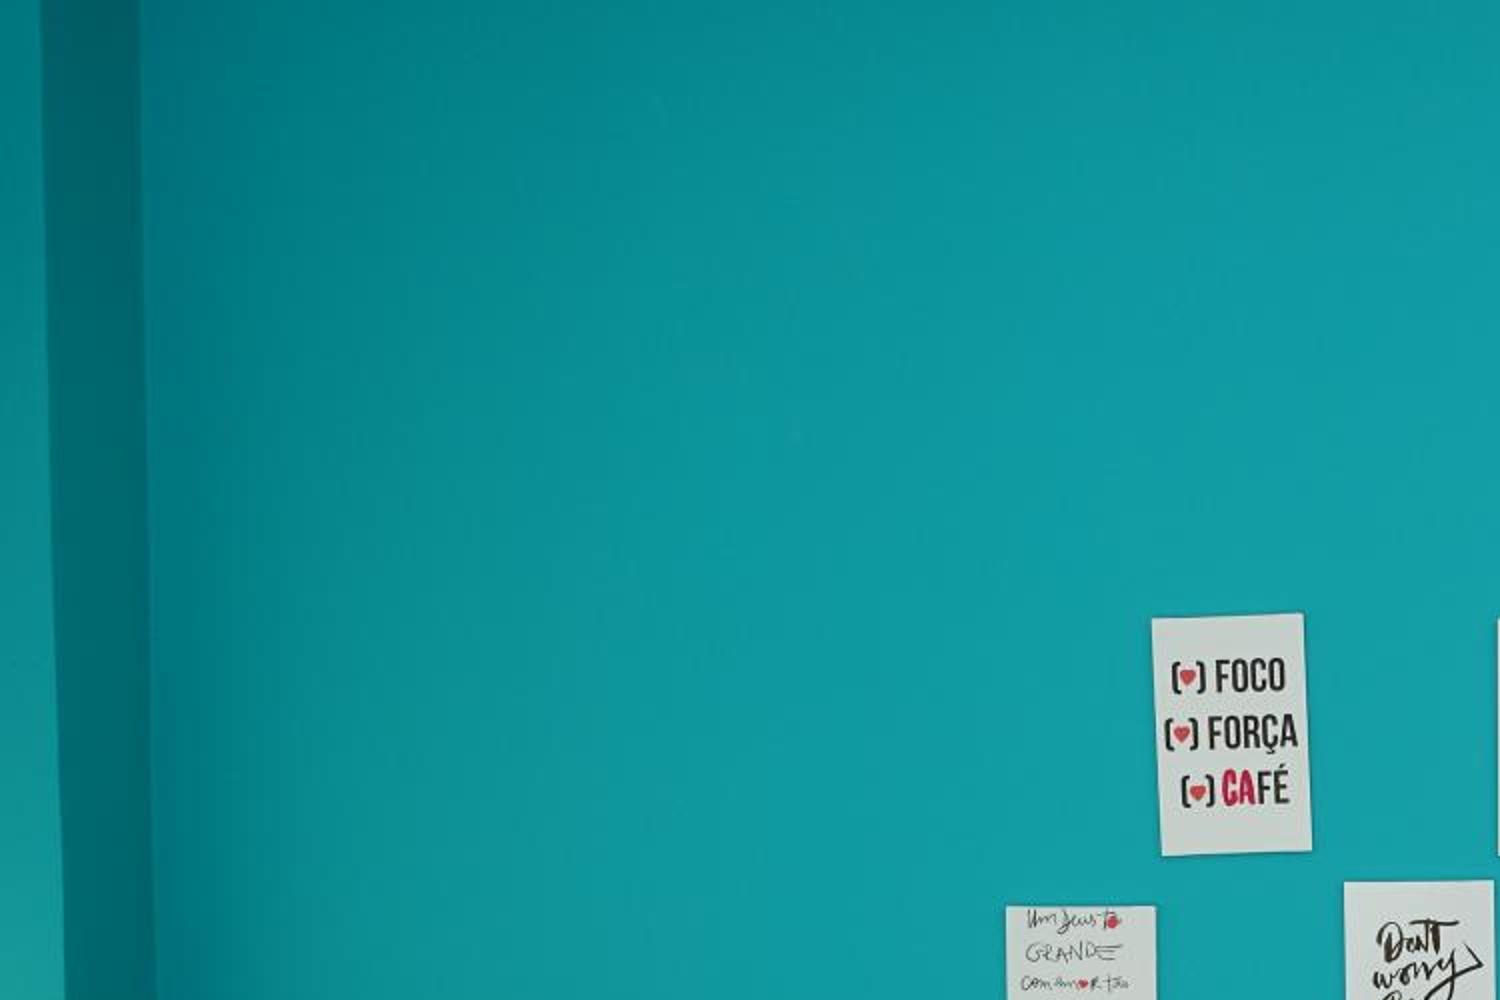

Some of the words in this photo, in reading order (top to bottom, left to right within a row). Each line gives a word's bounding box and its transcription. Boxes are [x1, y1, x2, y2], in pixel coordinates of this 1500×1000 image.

[1215, 657, 1286, 693] FOCO
[1208, 714, 1298, 754] FORÇA
[1222, 764, 1290, 807] CAFÉ
[1025, 940, 1124, 964] GRANDE
